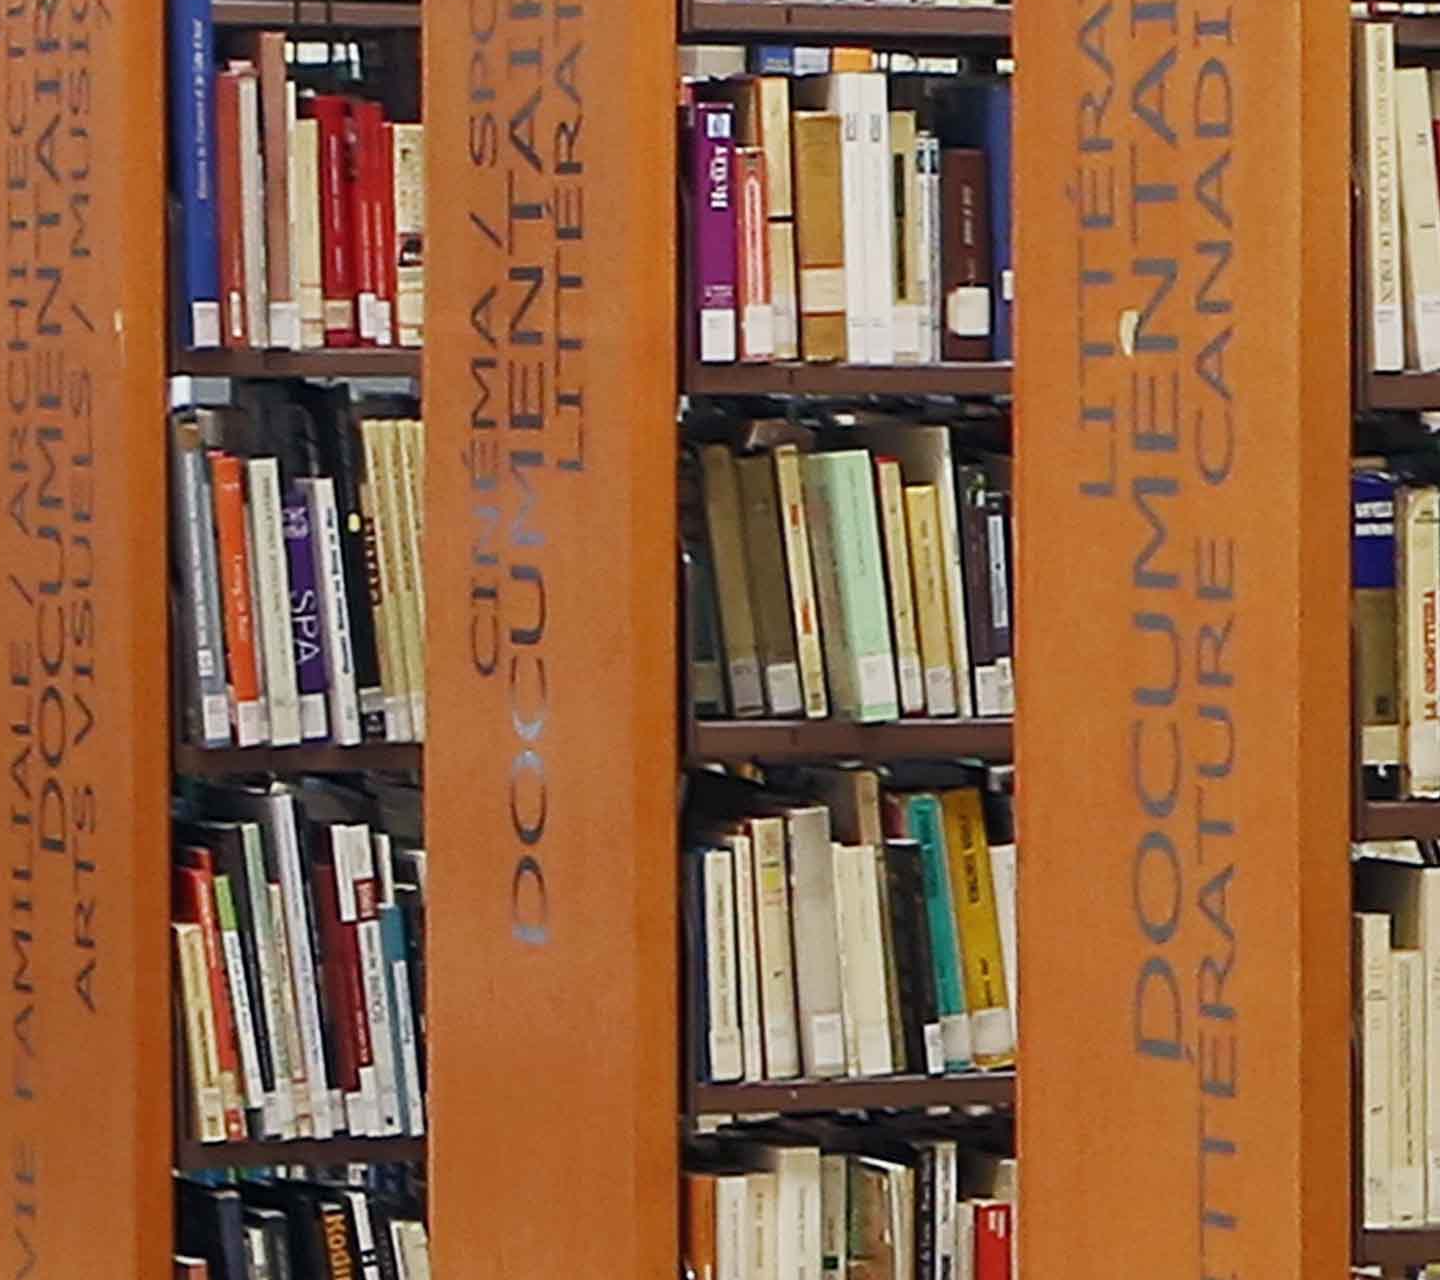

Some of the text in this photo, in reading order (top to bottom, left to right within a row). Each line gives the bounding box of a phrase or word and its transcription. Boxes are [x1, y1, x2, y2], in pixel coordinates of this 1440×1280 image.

[71, 372, 96, 744] VISUELS
[291, 591, 322, 665] SPA
[463, 285, 502, 676] CINÉMA
[8, 641, 36, 1101] FAMILIALE
[73, 782, 97, 1011] ARTS
